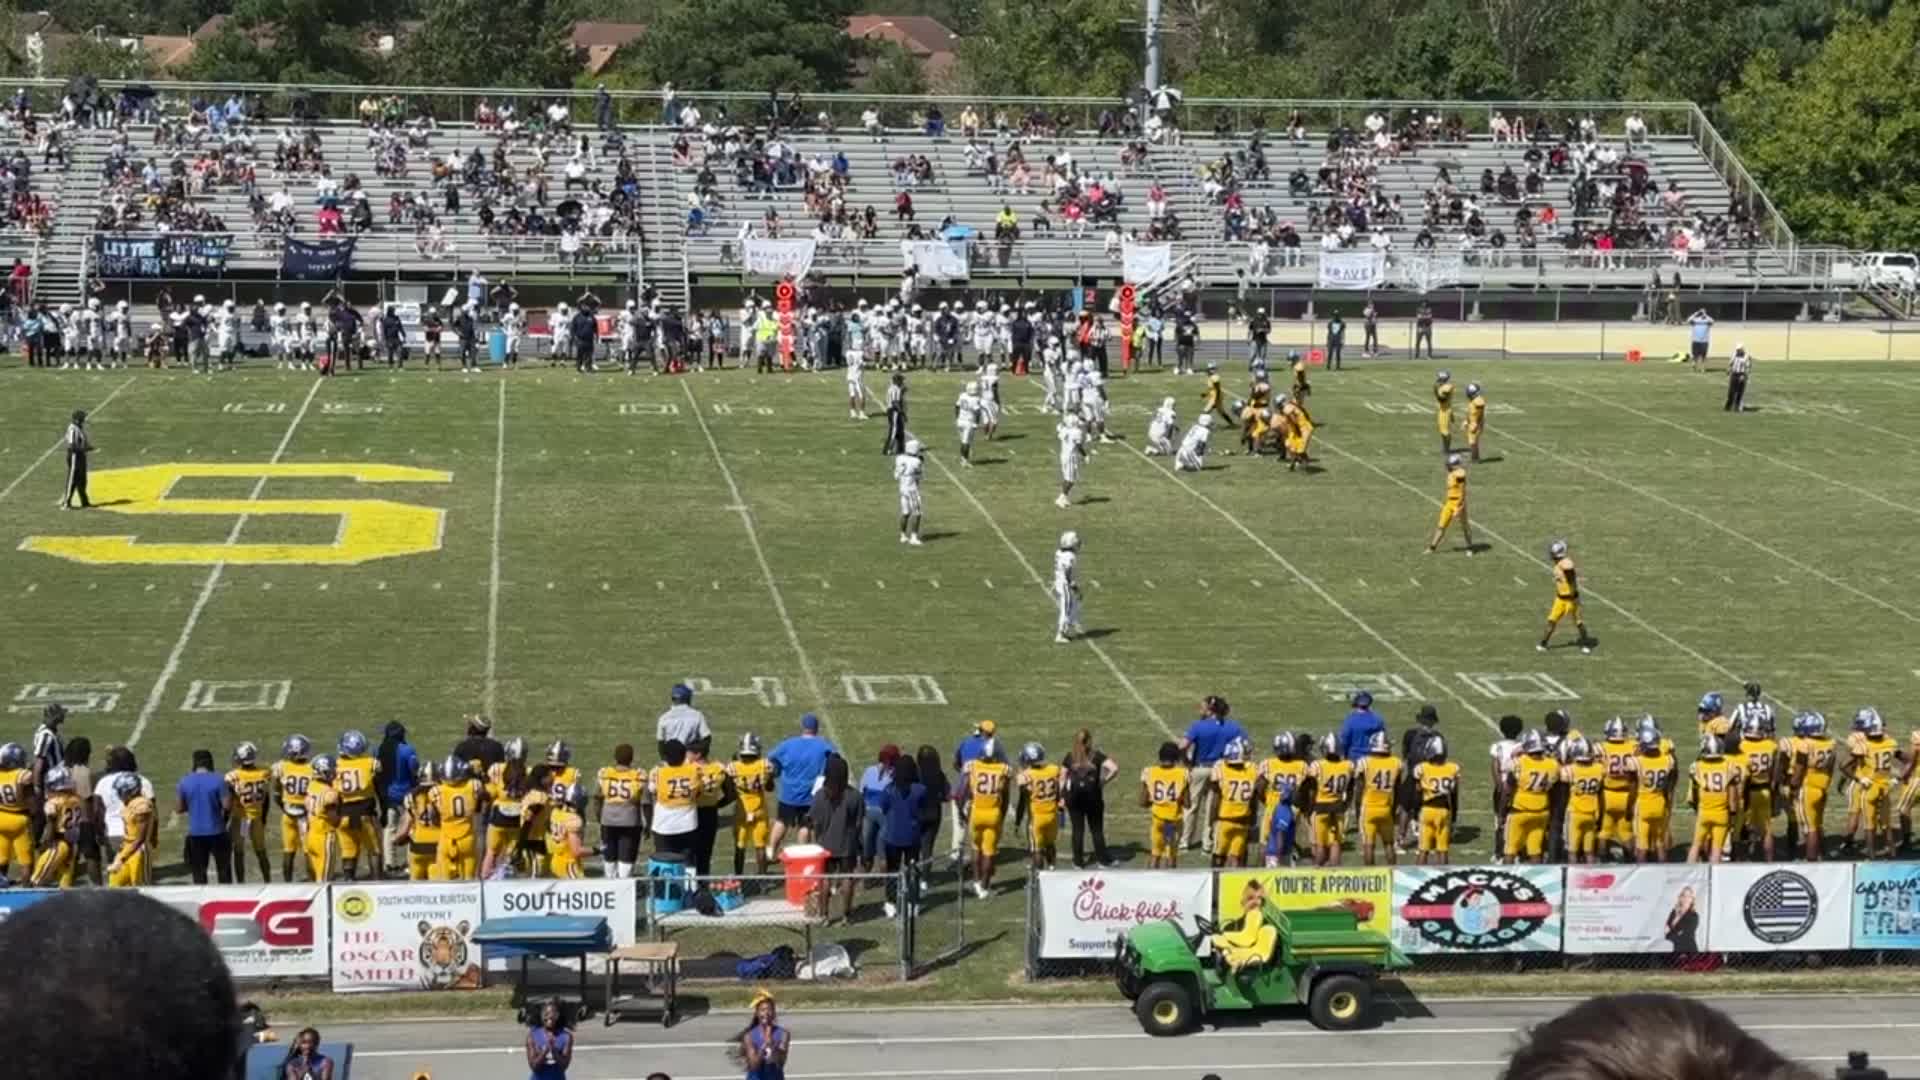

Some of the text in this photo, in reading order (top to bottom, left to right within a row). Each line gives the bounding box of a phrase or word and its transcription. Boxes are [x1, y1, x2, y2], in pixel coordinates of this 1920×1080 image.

[1872, 751, 1892, 771] 12
[341, 770, 362, 793] 61
[607, 779, 632, 800] 65
[666, 778, 692, 799] 75
[977, 773, 998, 796] 21
[1154, 780, 1176, 801] 64
[1372, 770, 1393, 790] 41
[1703, 773, 1723, 793] 19
[1228, 781, 1251, 801] 72
[453, 796, 465, 819] 0
[1275, 875, 1388, 894] YOU'RE APPROVED!
[1420, 873, 1534, 902] MACK'S
[503, 891, 616, 911] SOUTHSIDE
[1422, 919, 1532, 945] GARAGE
[340, 949, 414, 961] OSCAR
